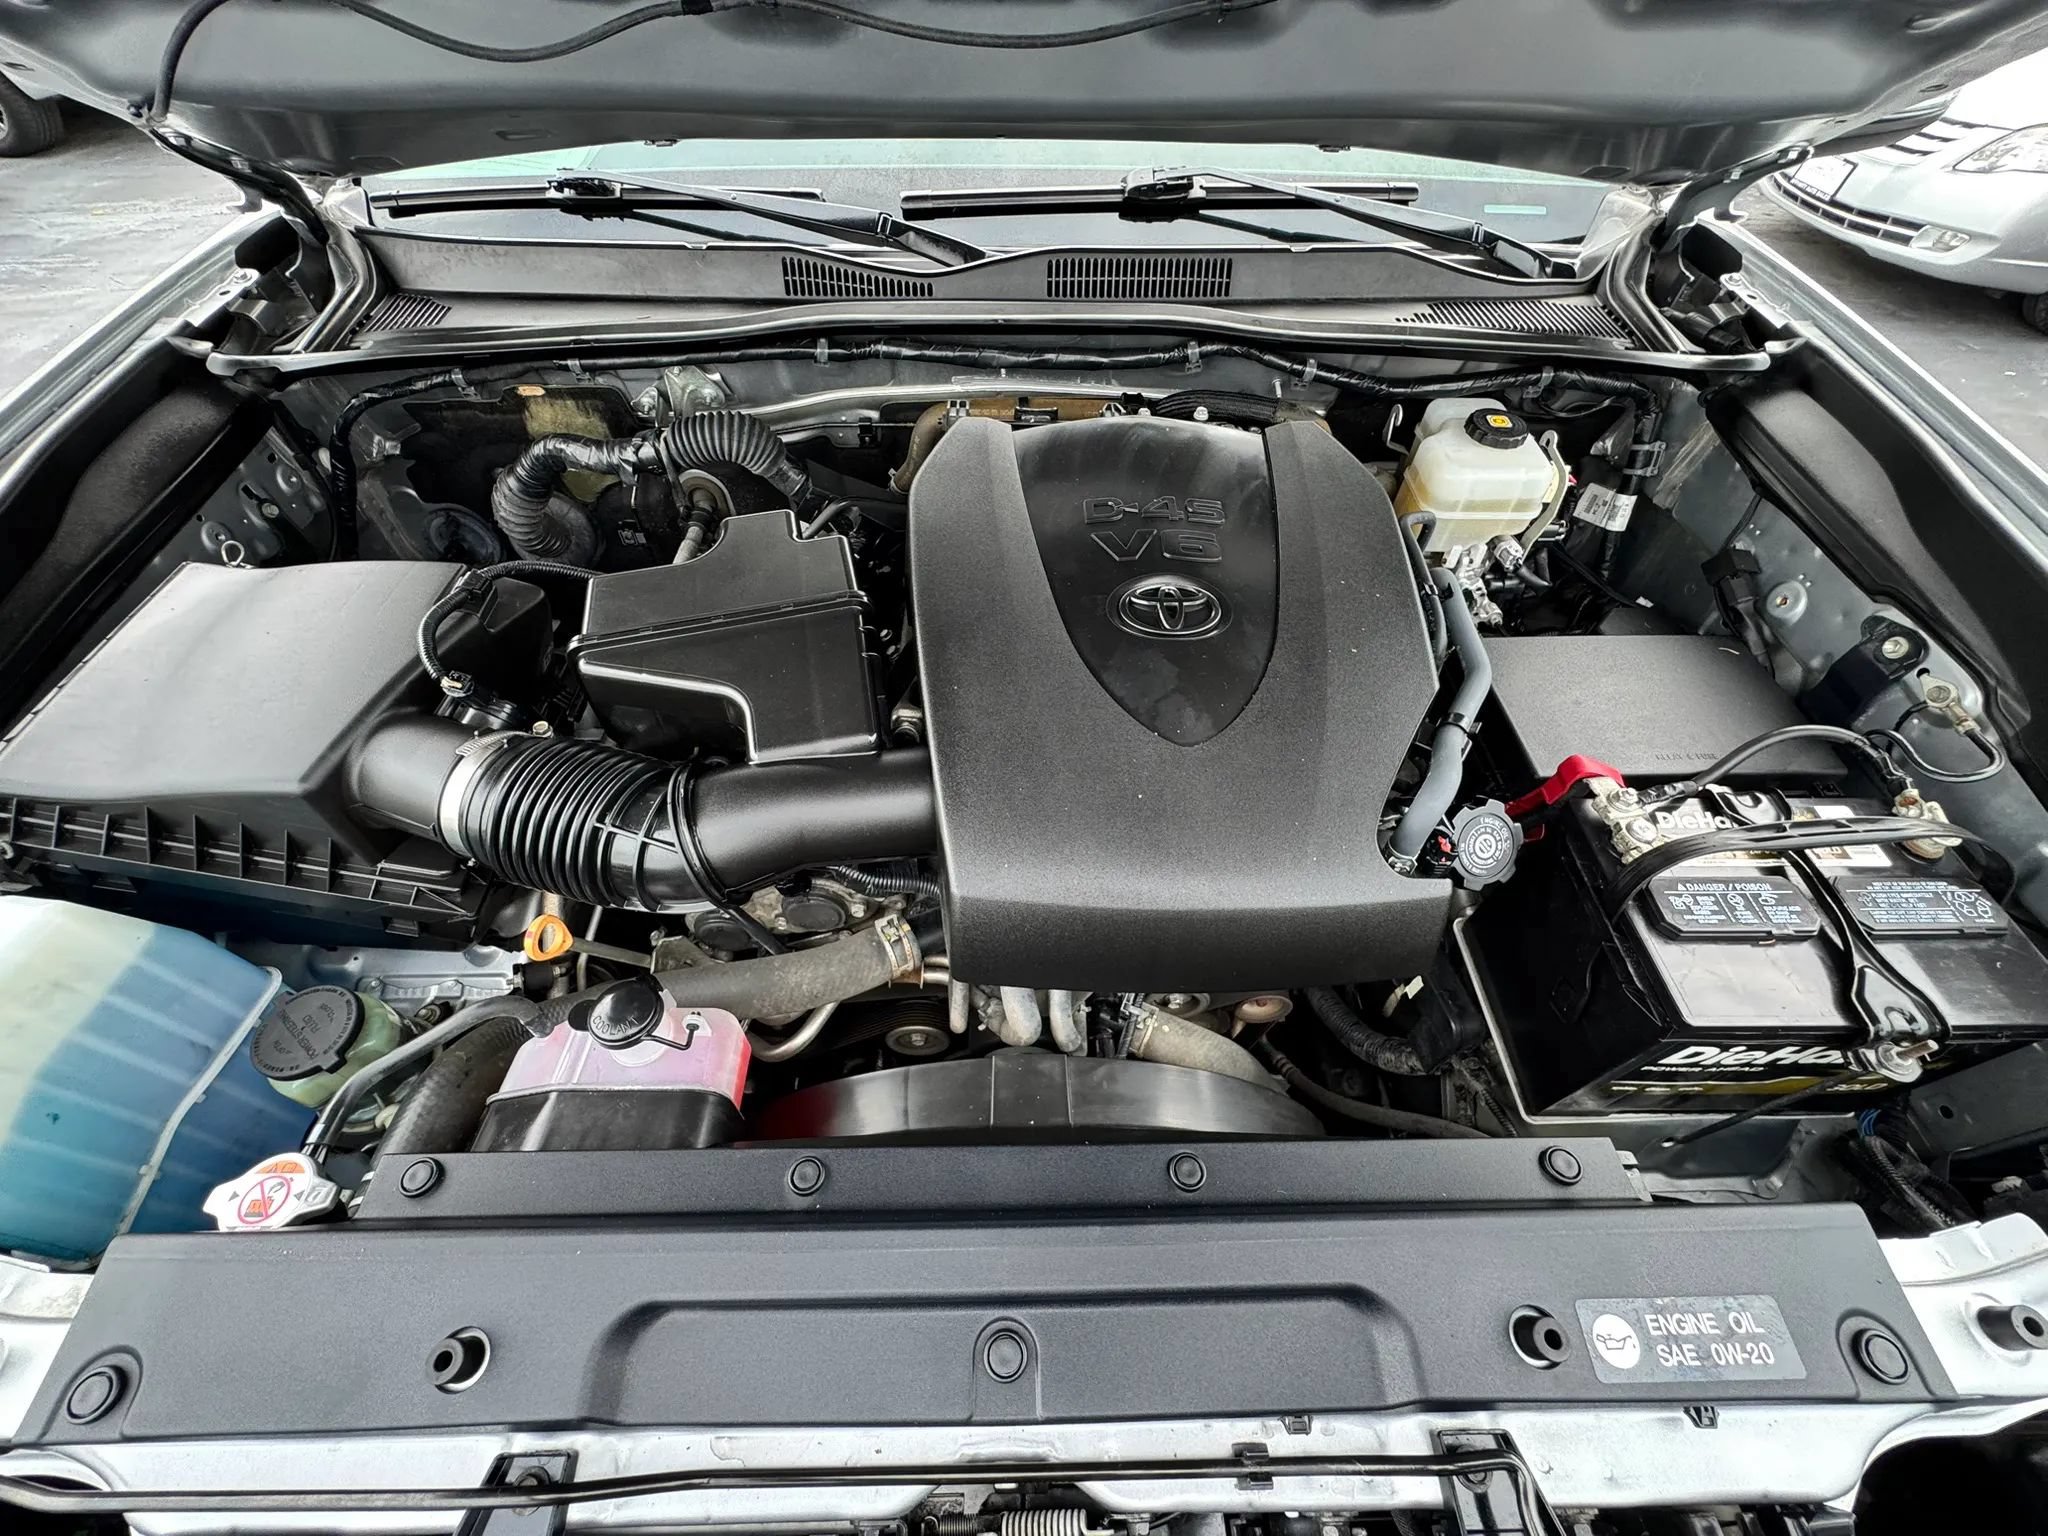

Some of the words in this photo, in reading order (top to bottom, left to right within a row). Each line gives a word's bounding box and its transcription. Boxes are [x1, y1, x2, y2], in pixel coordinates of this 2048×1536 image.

[1083, 496, 1226, 524] D-4S
[1090, 529, 1223, 562] V6
[1655, 811, 1739, 829] DieHa
[1685, 883, 1727, 891] DANGER
[1736, 882, 1773, 891] POISON
[592, 1014, 640, 1036] COOLANT
[296, 1035, 319, 1060] POWER
[1657, 1045, 1845, 1065] DieHa
[1644, 1313, 1721, 1336] ENGINE
[1729, 1311, 1765, 1334] OIL
[1656, 1343, 1702, 1367] SAE
[1711, 1342, 1775, 1366] 0W-20
